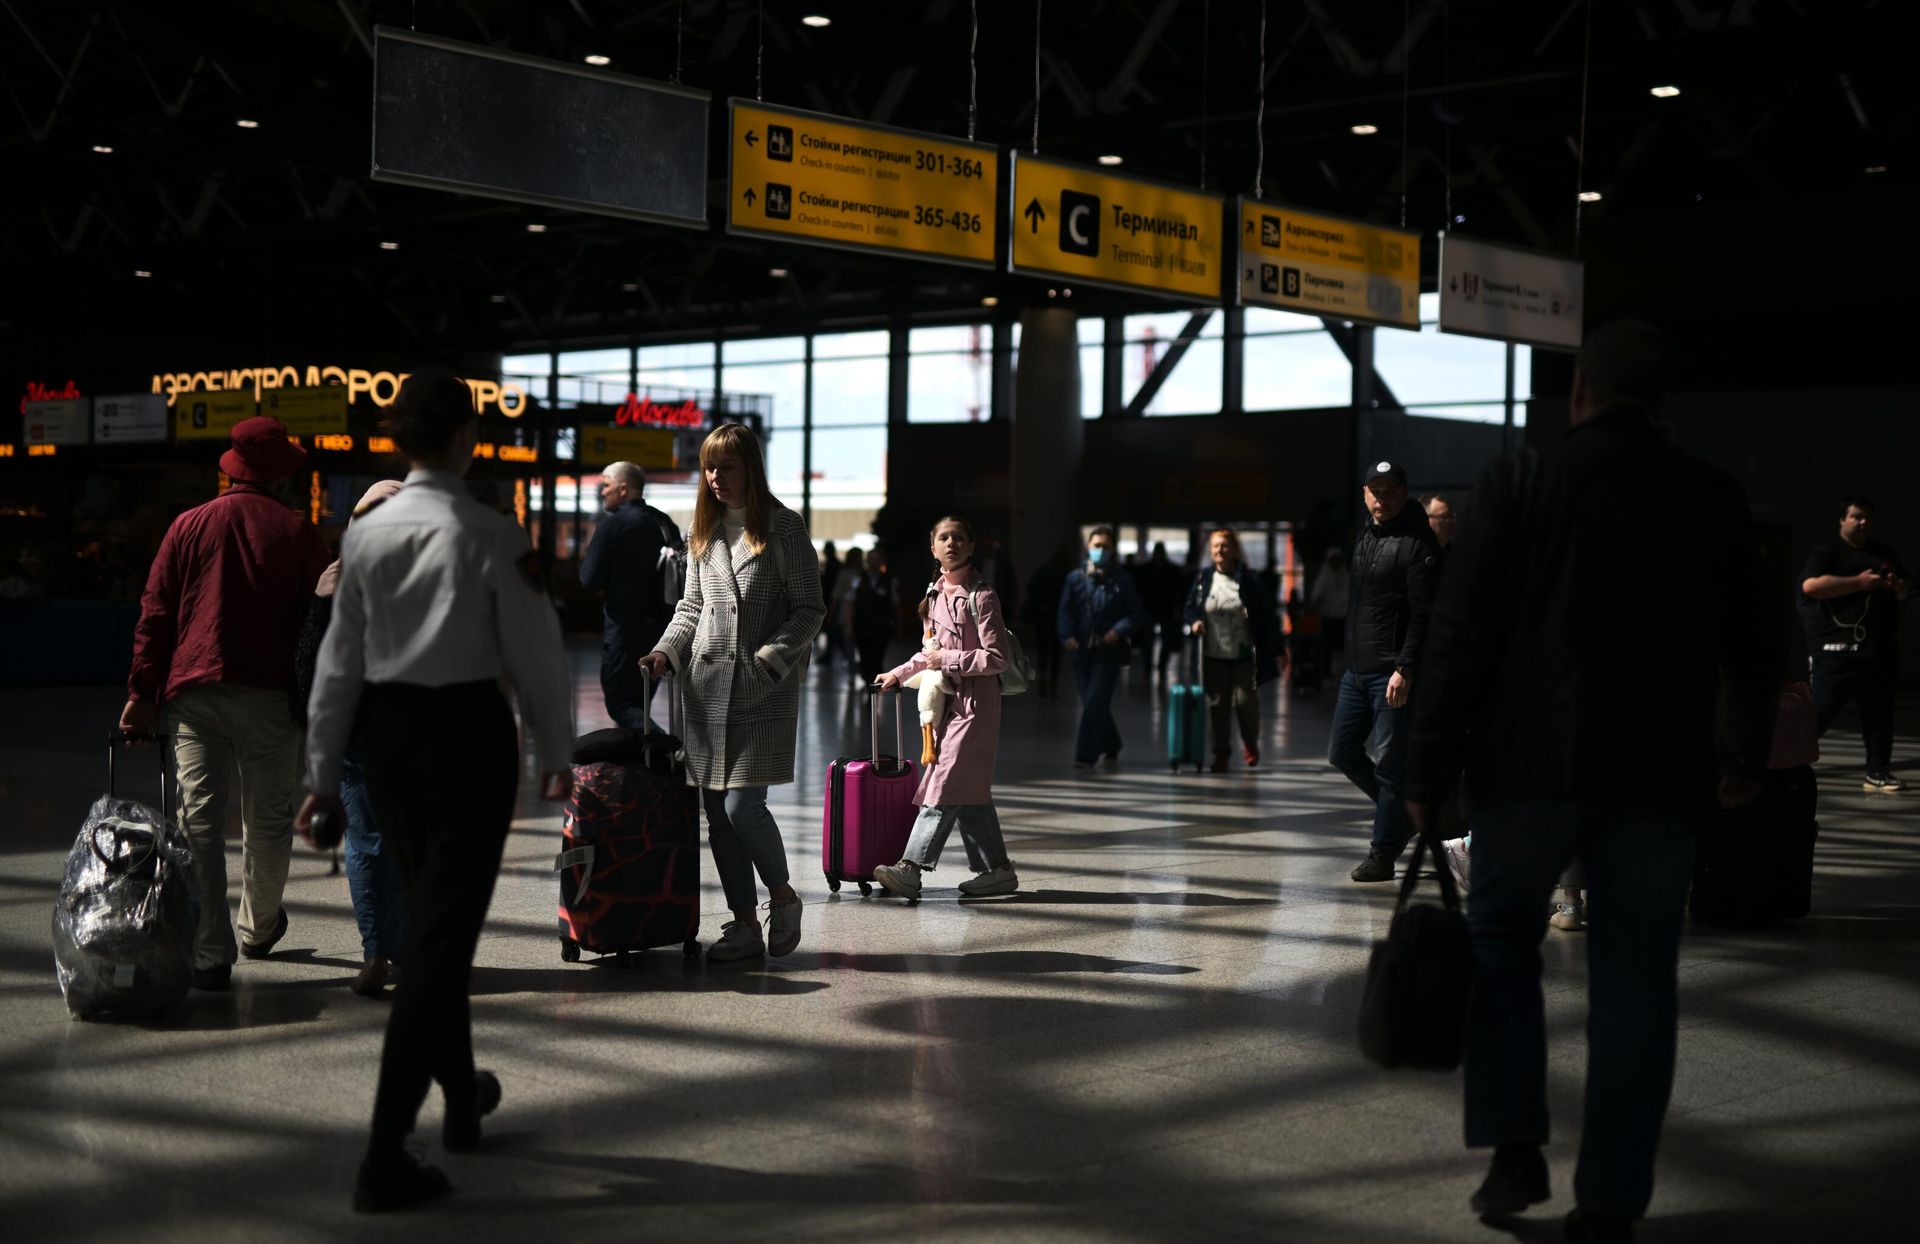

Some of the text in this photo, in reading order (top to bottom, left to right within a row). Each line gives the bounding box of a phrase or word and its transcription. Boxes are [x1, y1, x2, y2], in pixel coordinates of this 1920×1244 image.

[800, 133, 841, 153] Стойки
[842, 144, 912, 166] регистрации
[915, 149, 984, 181] 301-364
[799, 190, 839, 210] Стойки
[841, 200, 911, 221] регистрации
[913, 204, 983, 234] 365-436
[1112, 205, 1198, 241] Терминал
[1111, 244, 1164, 270] Terminal
